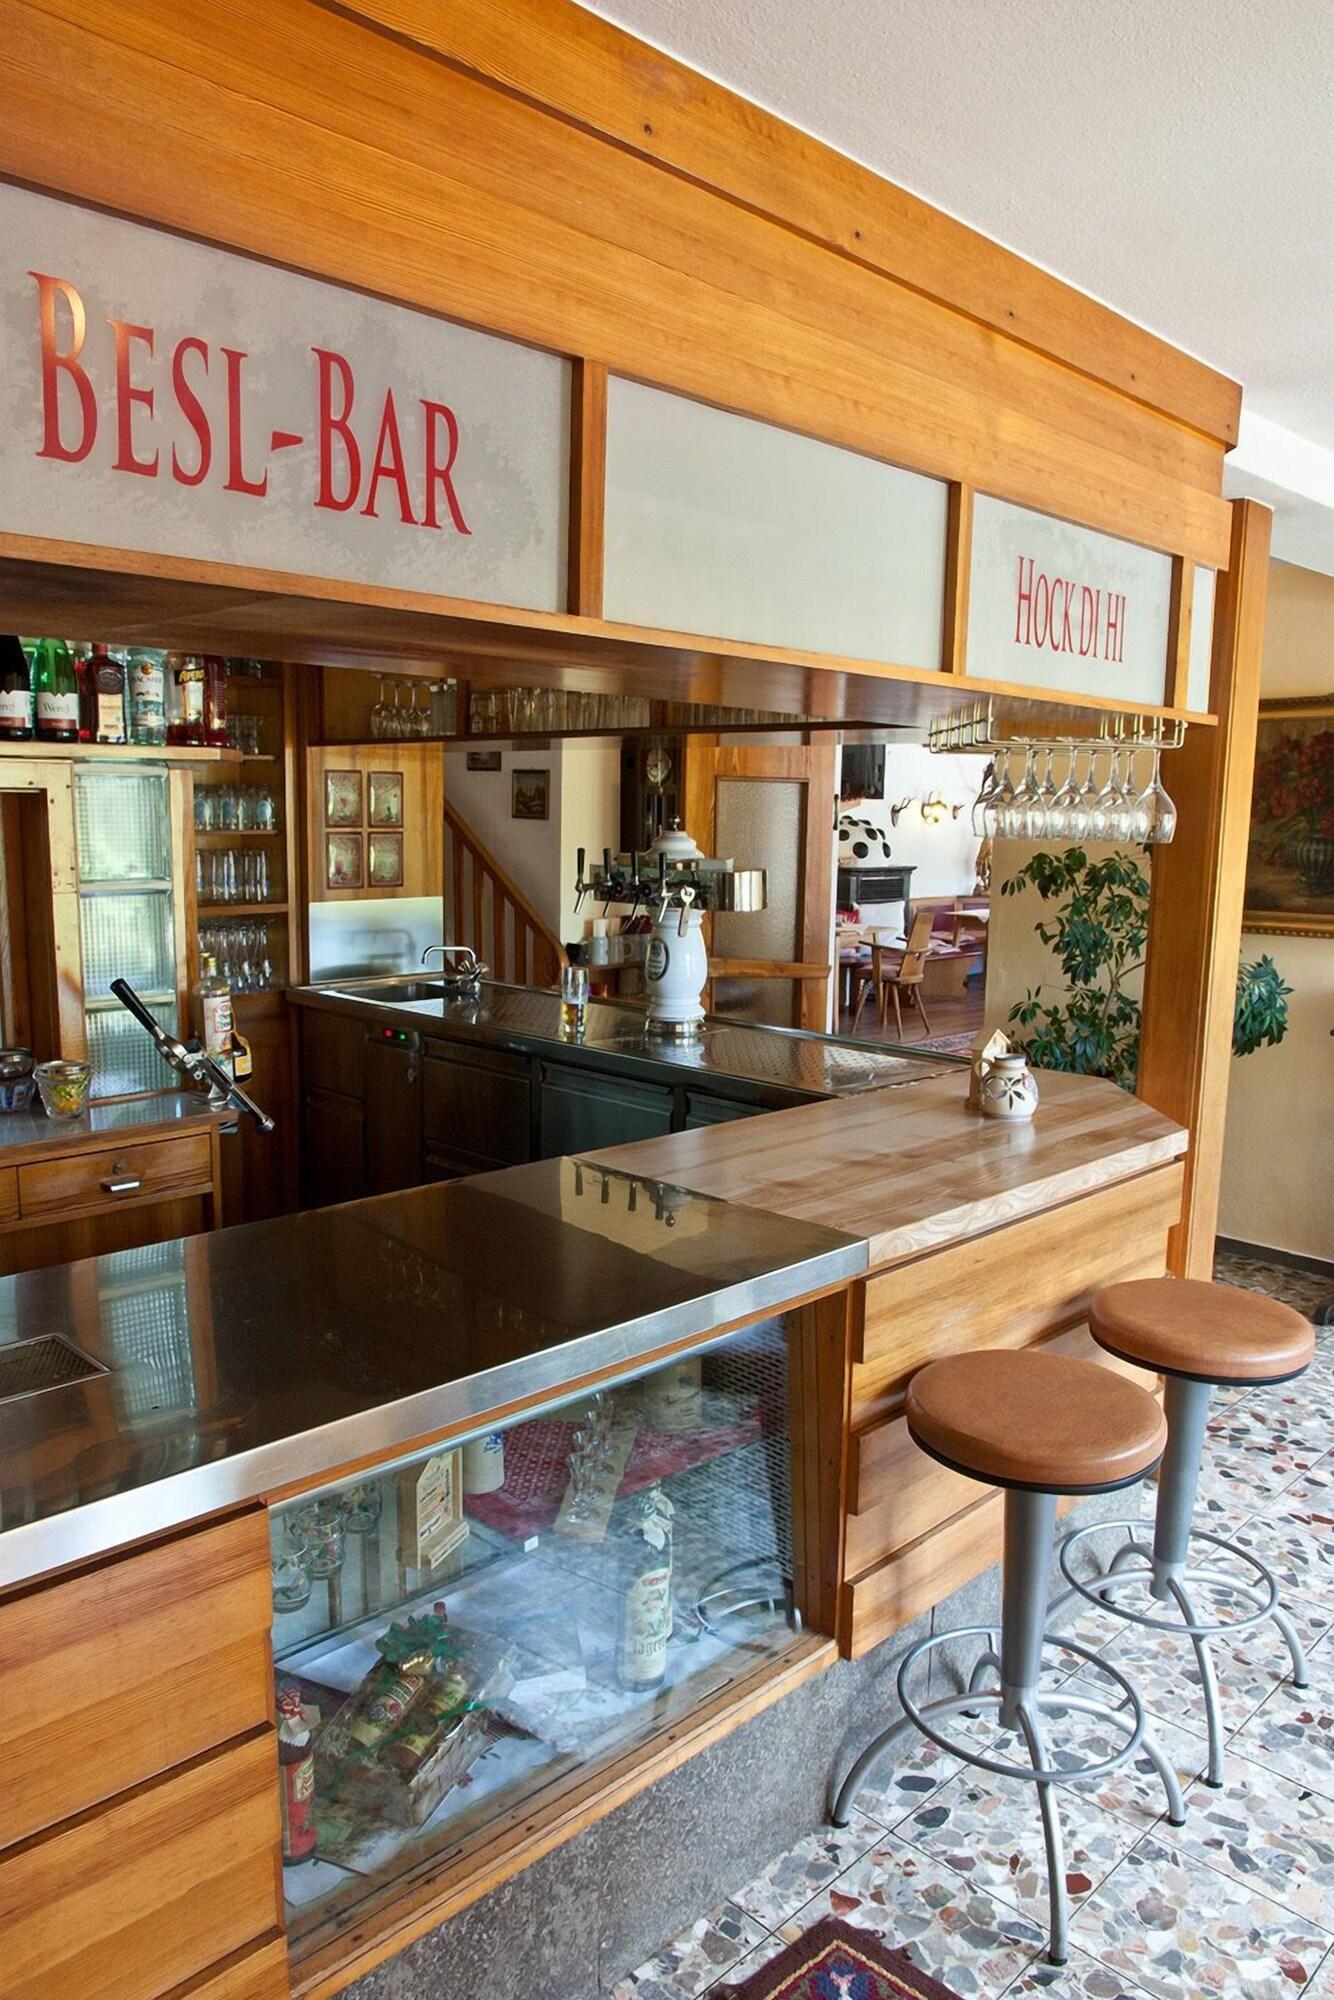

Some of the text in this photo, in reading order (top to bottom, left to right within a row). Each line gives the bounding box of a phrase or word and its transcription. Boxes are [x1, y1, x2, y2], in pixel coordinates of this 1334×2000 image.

[27, 271, 472, 535] BESL-BAR
[1014, 556, 1126, 662] HOCK DI HI
[179, 669, 205, 683] APERO
